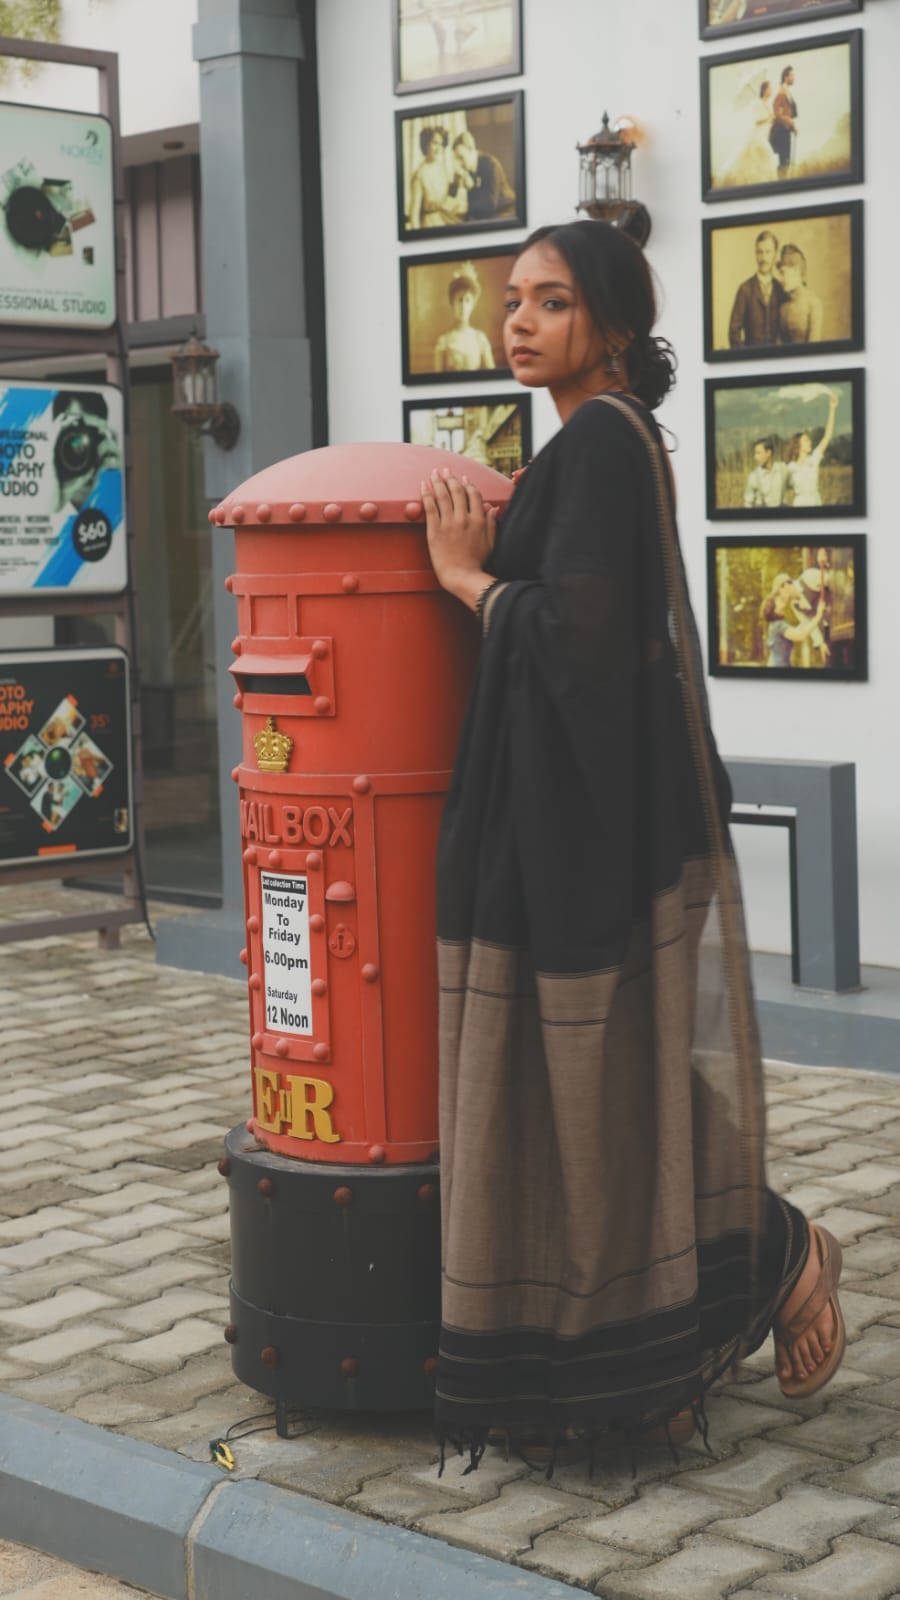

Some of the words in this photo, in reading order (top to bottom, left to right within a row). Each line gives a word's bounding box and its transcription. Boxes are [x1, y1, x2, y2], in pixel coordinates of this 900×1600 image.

[62, 298, 107, 314] STUDIO
[0, 480, 39, 497] UDIO
[78, 519, 107, 544] $60
[264, 892, 304, 912] Monday
[276, 913, 290, 927] To
[269, 927, 301, 946] Friday
[265, 950, 308, 971] 6.00pm
[267, 986, 298, 1004] Saturday
[267, 1004, 278, 1024] 12
[280, 1007, 309, 1028] Noon
